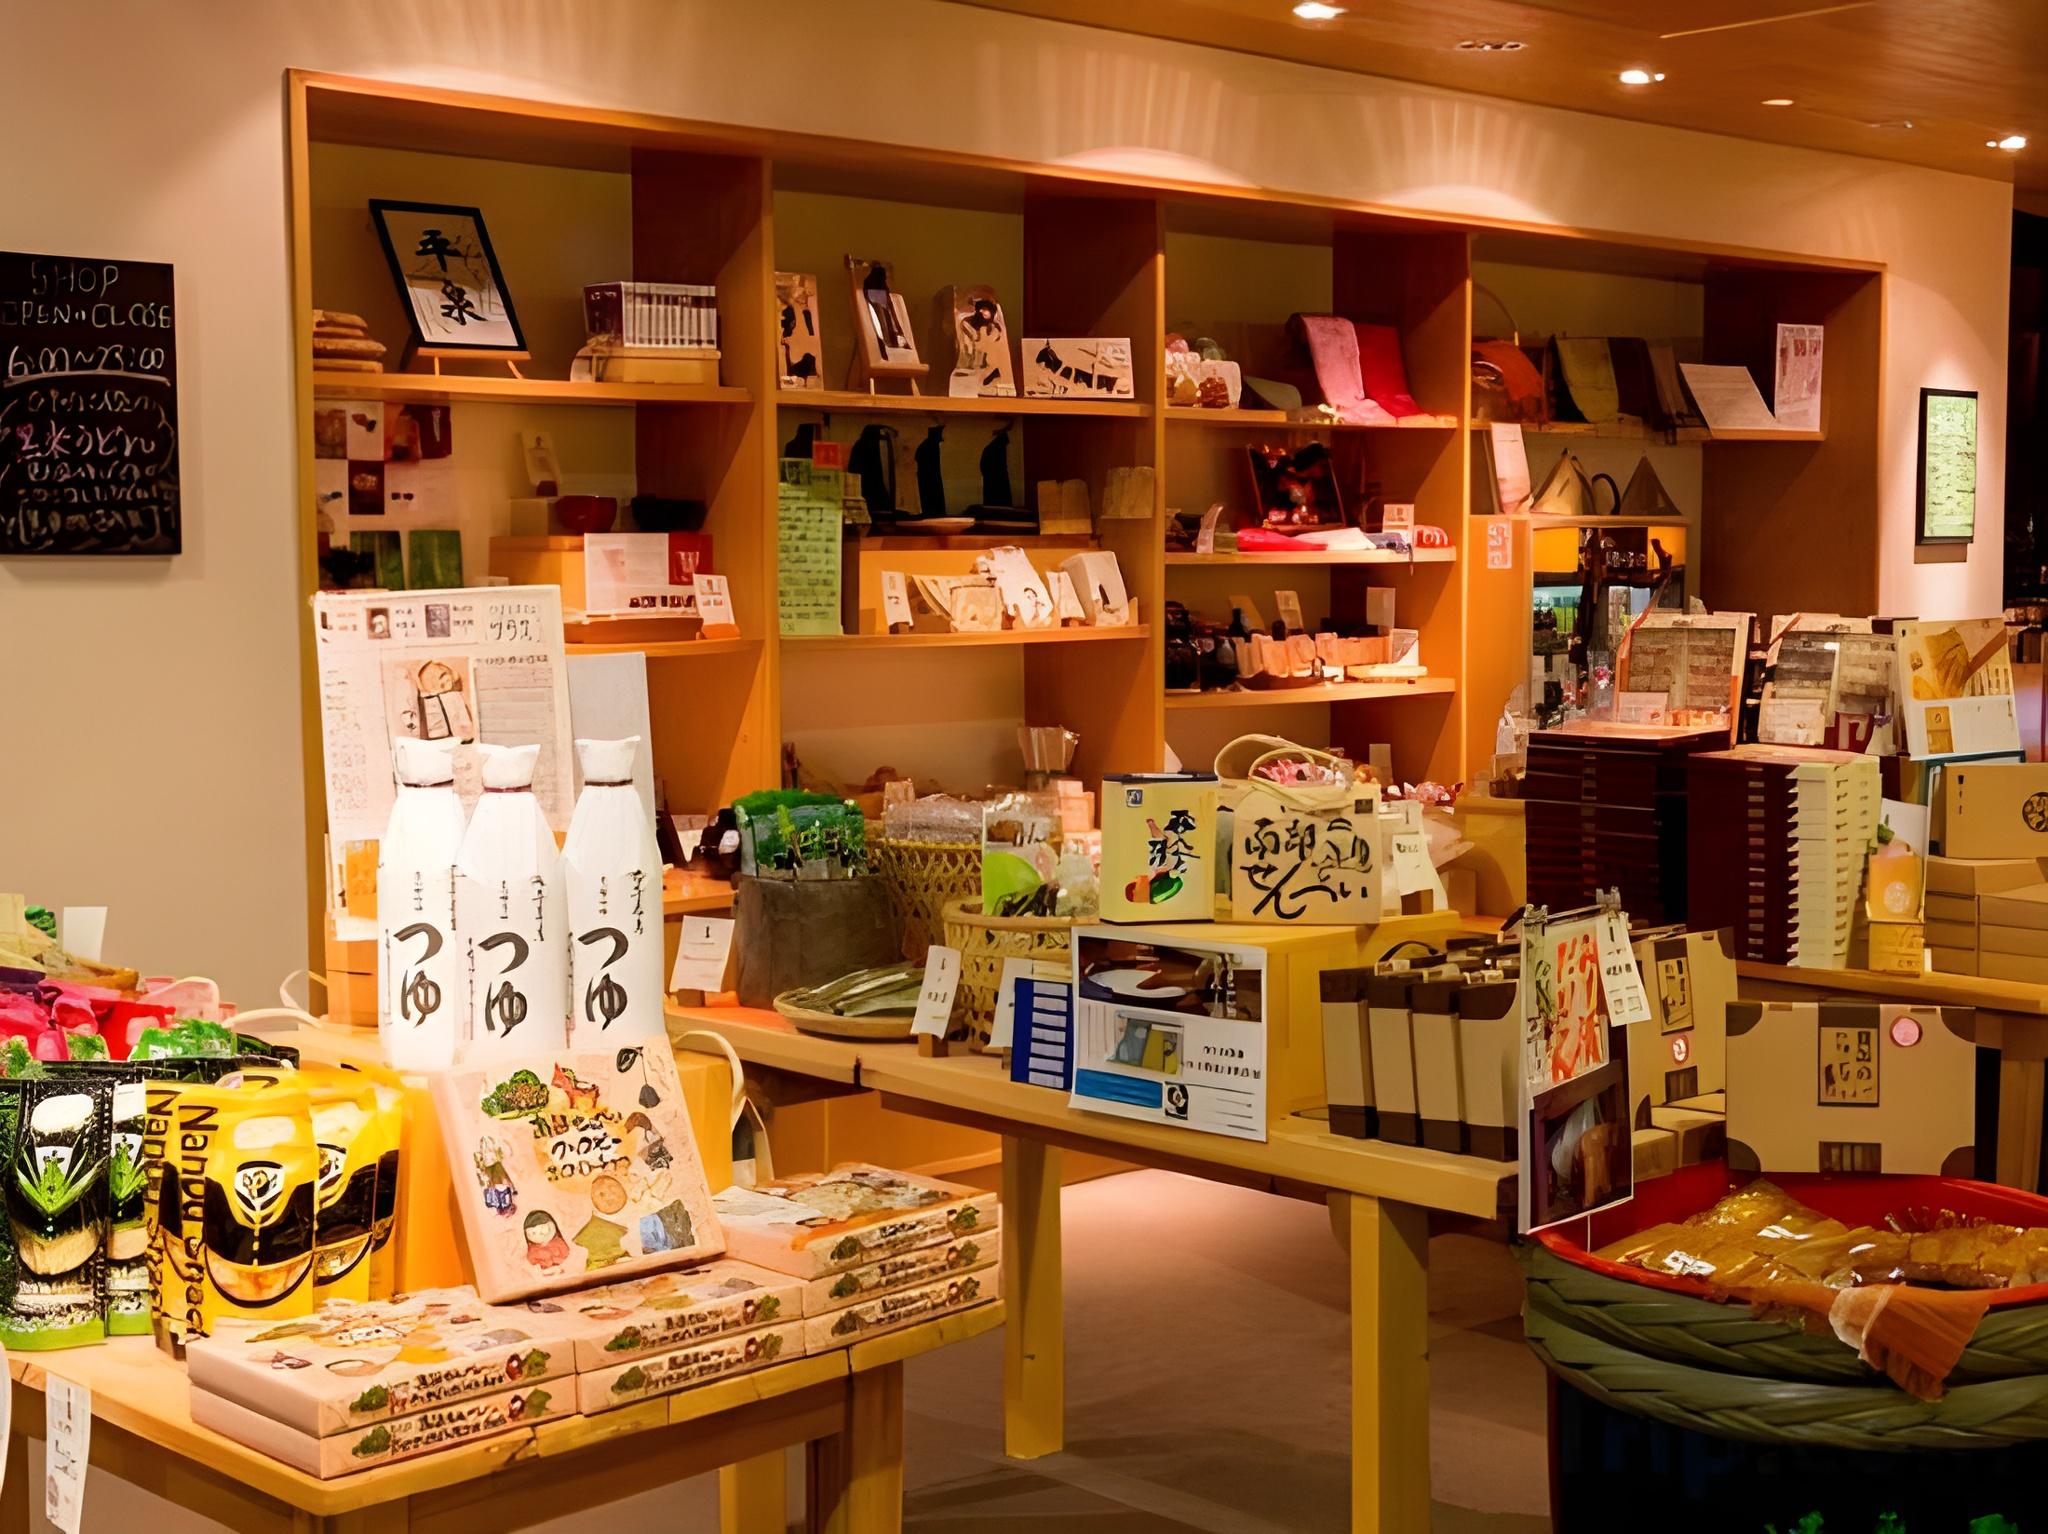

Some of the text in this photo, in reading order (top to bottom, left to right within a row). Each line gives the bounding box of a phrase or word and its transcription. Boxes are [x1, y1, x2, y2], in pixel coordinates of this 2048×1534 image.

[31, 259, 119, 298] SHOP
[393, 922, 443, 1028] つゆ
[478, 931, 530, 1038] つゆ
[577, 927, 630, 1031] つゆ
